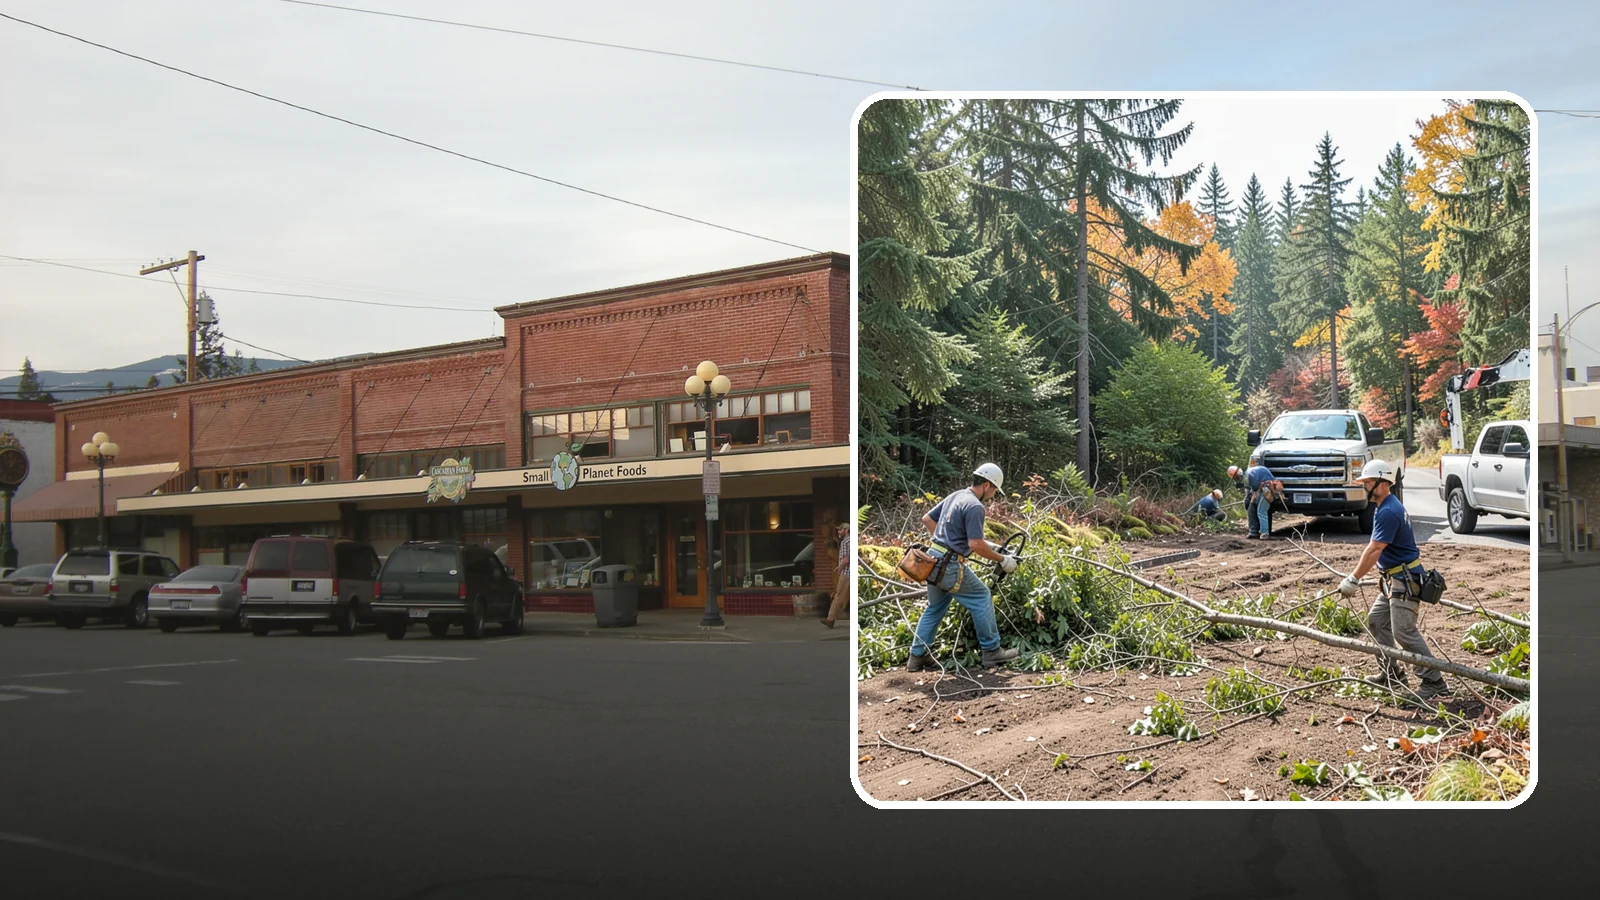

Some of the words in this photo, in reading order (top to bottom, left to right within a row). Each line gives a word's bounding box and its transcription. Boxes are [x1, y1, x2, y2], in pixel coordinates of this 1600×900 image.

[523, 470, 549, 483] Small
[582, 467, 614, 479] Planet
[617, 464, 647, 477] Foods
